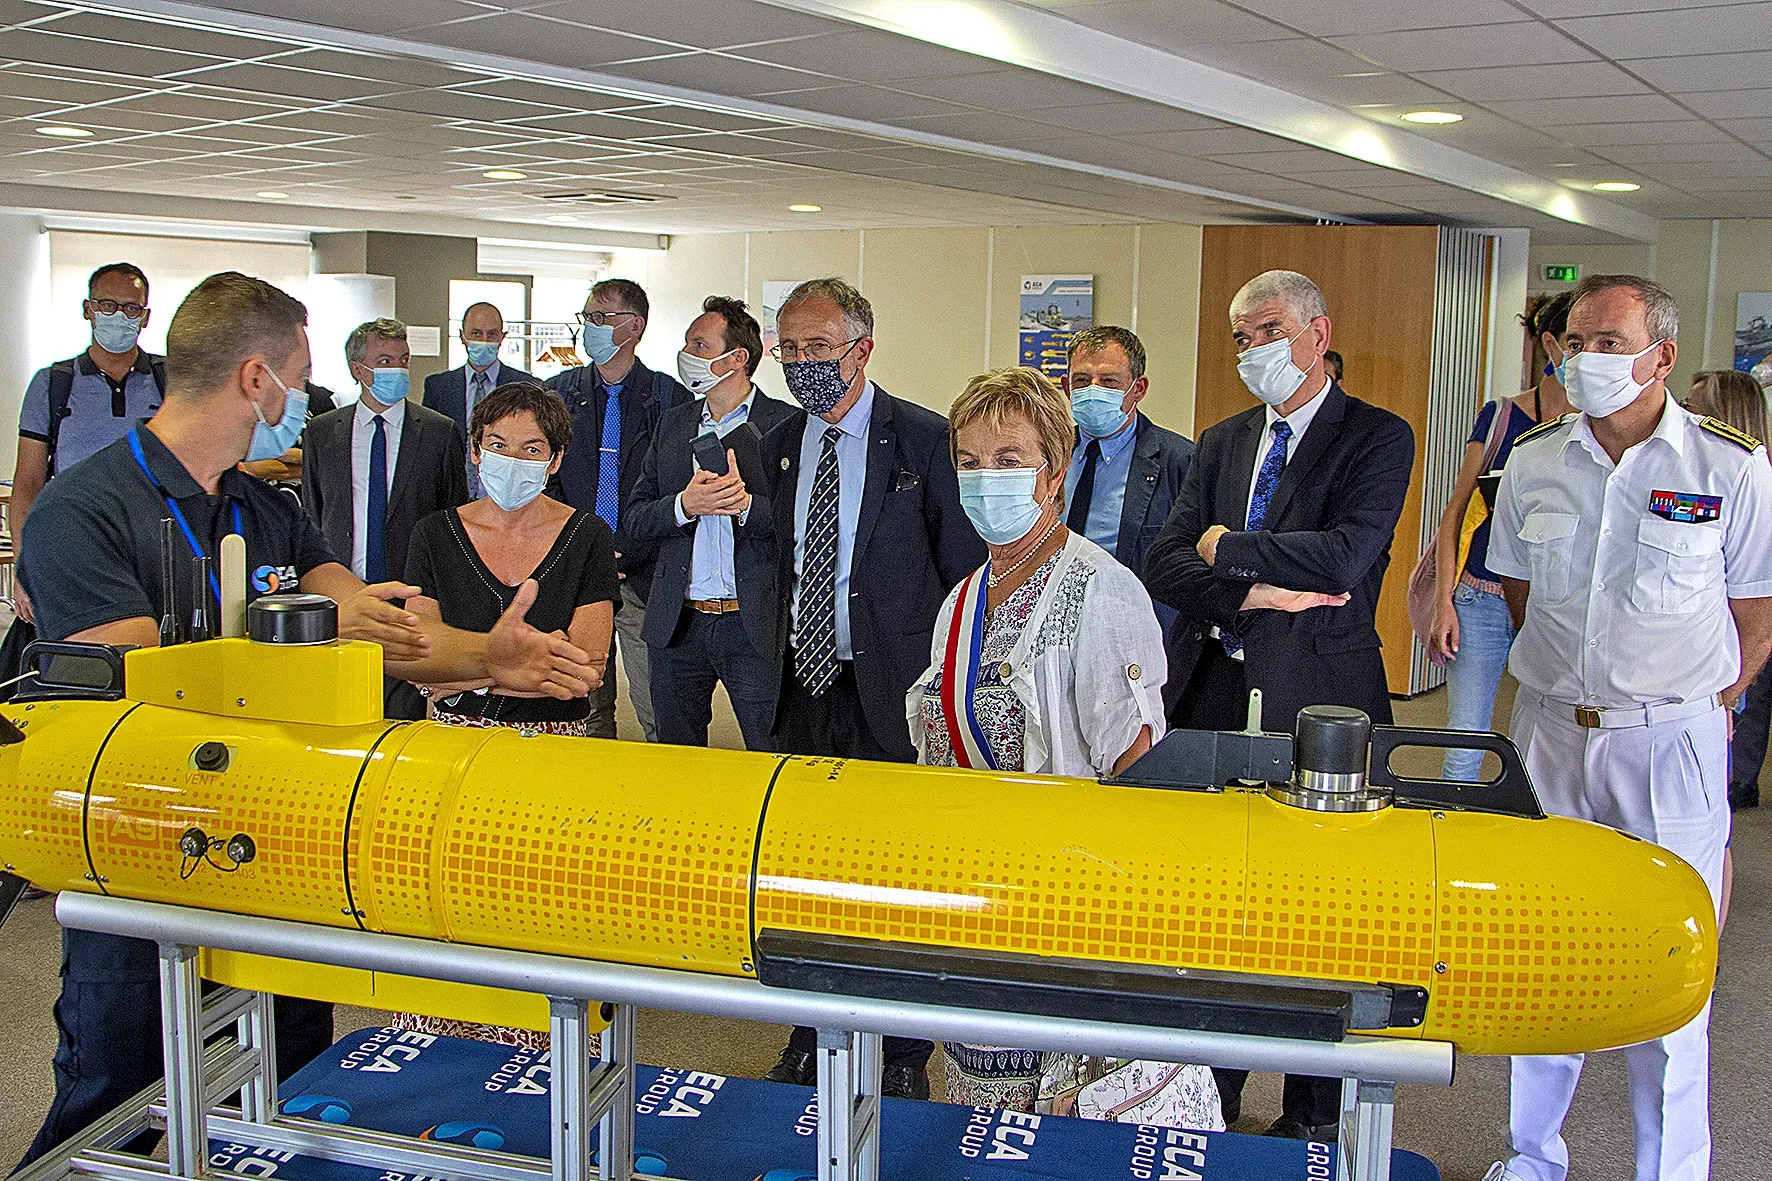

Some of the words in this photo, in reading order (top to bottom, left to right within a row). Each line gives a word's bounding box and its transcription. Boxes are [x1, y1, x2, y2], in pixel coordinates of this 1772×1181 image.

[184, 773, 217, 787] VENT
[110, 814, 157, 841] A9
[340, 1026, 401, 1069] GROUP
[359, 1030, 439, 1073] ECA
[484, 1047, 539, 1092] GROUP
[504, 1051, 551, 1095] CA
[657, 1070, 727, 1118] ECA
[985, 1109, 1042, 1160] ECA
[1129, 1125, 1159, 1179] GROUP
[1159, 1129, 1208, 1181] ECA
[1306, 1141, 1330, 1181] GRO
